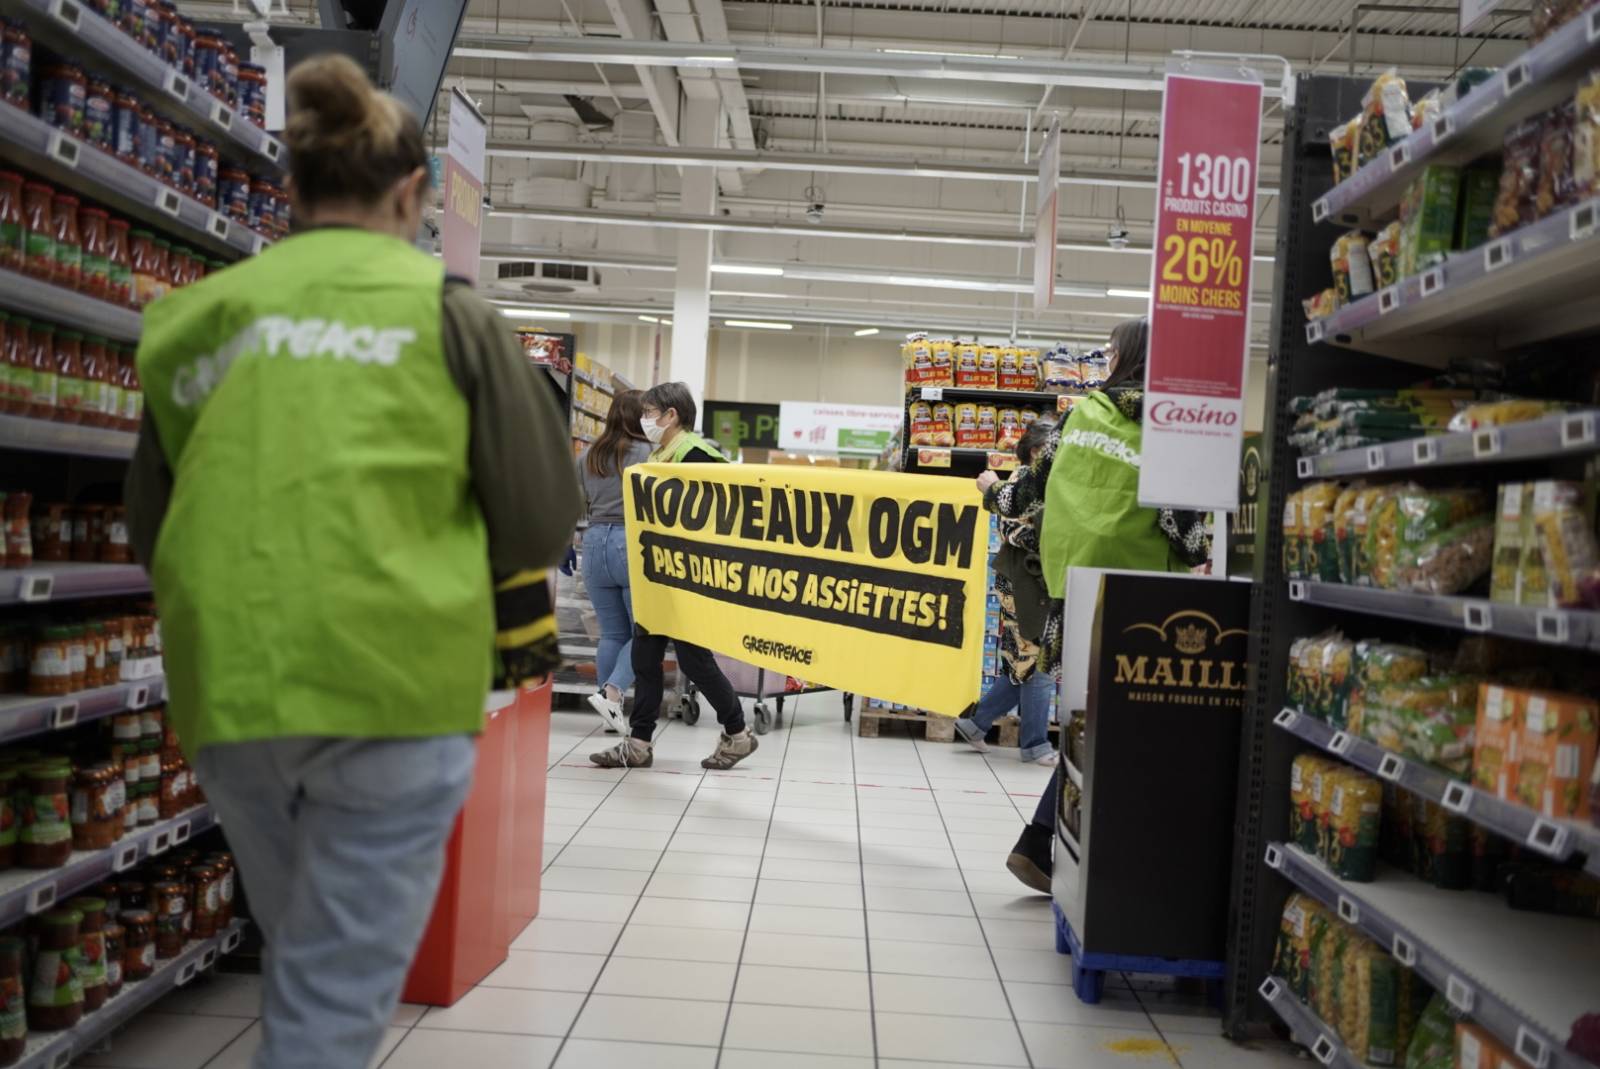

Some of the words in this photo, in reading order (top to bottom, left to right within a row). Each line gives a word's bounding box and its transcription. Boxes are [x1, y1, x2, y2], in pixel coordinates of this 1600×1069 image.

[1178, 152, 1251, 202] 1300
[1164, 197, 1211, 215] PRODUITS
[1212, 201, 1248, 218] CASINO
[1176, 218, 1189, 232] EN
[1190, 219, 1233, 236] MOYENNE
[1162, 234, 1243, 287] 26%
[1160, 283, 1199, 305] MOINS
[1201, 288, 1241, 309] CHERS
[1150, 400, 1237, 427] Casino
[630, 472, 854, 553] NOUVEAUX
[868, 497, 978, 569] OGM
[652, 545, 686, 580] PAS
[688, 553, 742, 593] DANS
[747, 566, 799, 602] NOS
[742, 634, 813, 665] GREENPEACE
[1128, 691, 1165, 703] MAISON
[1208, 696, 1221, 706] EN
